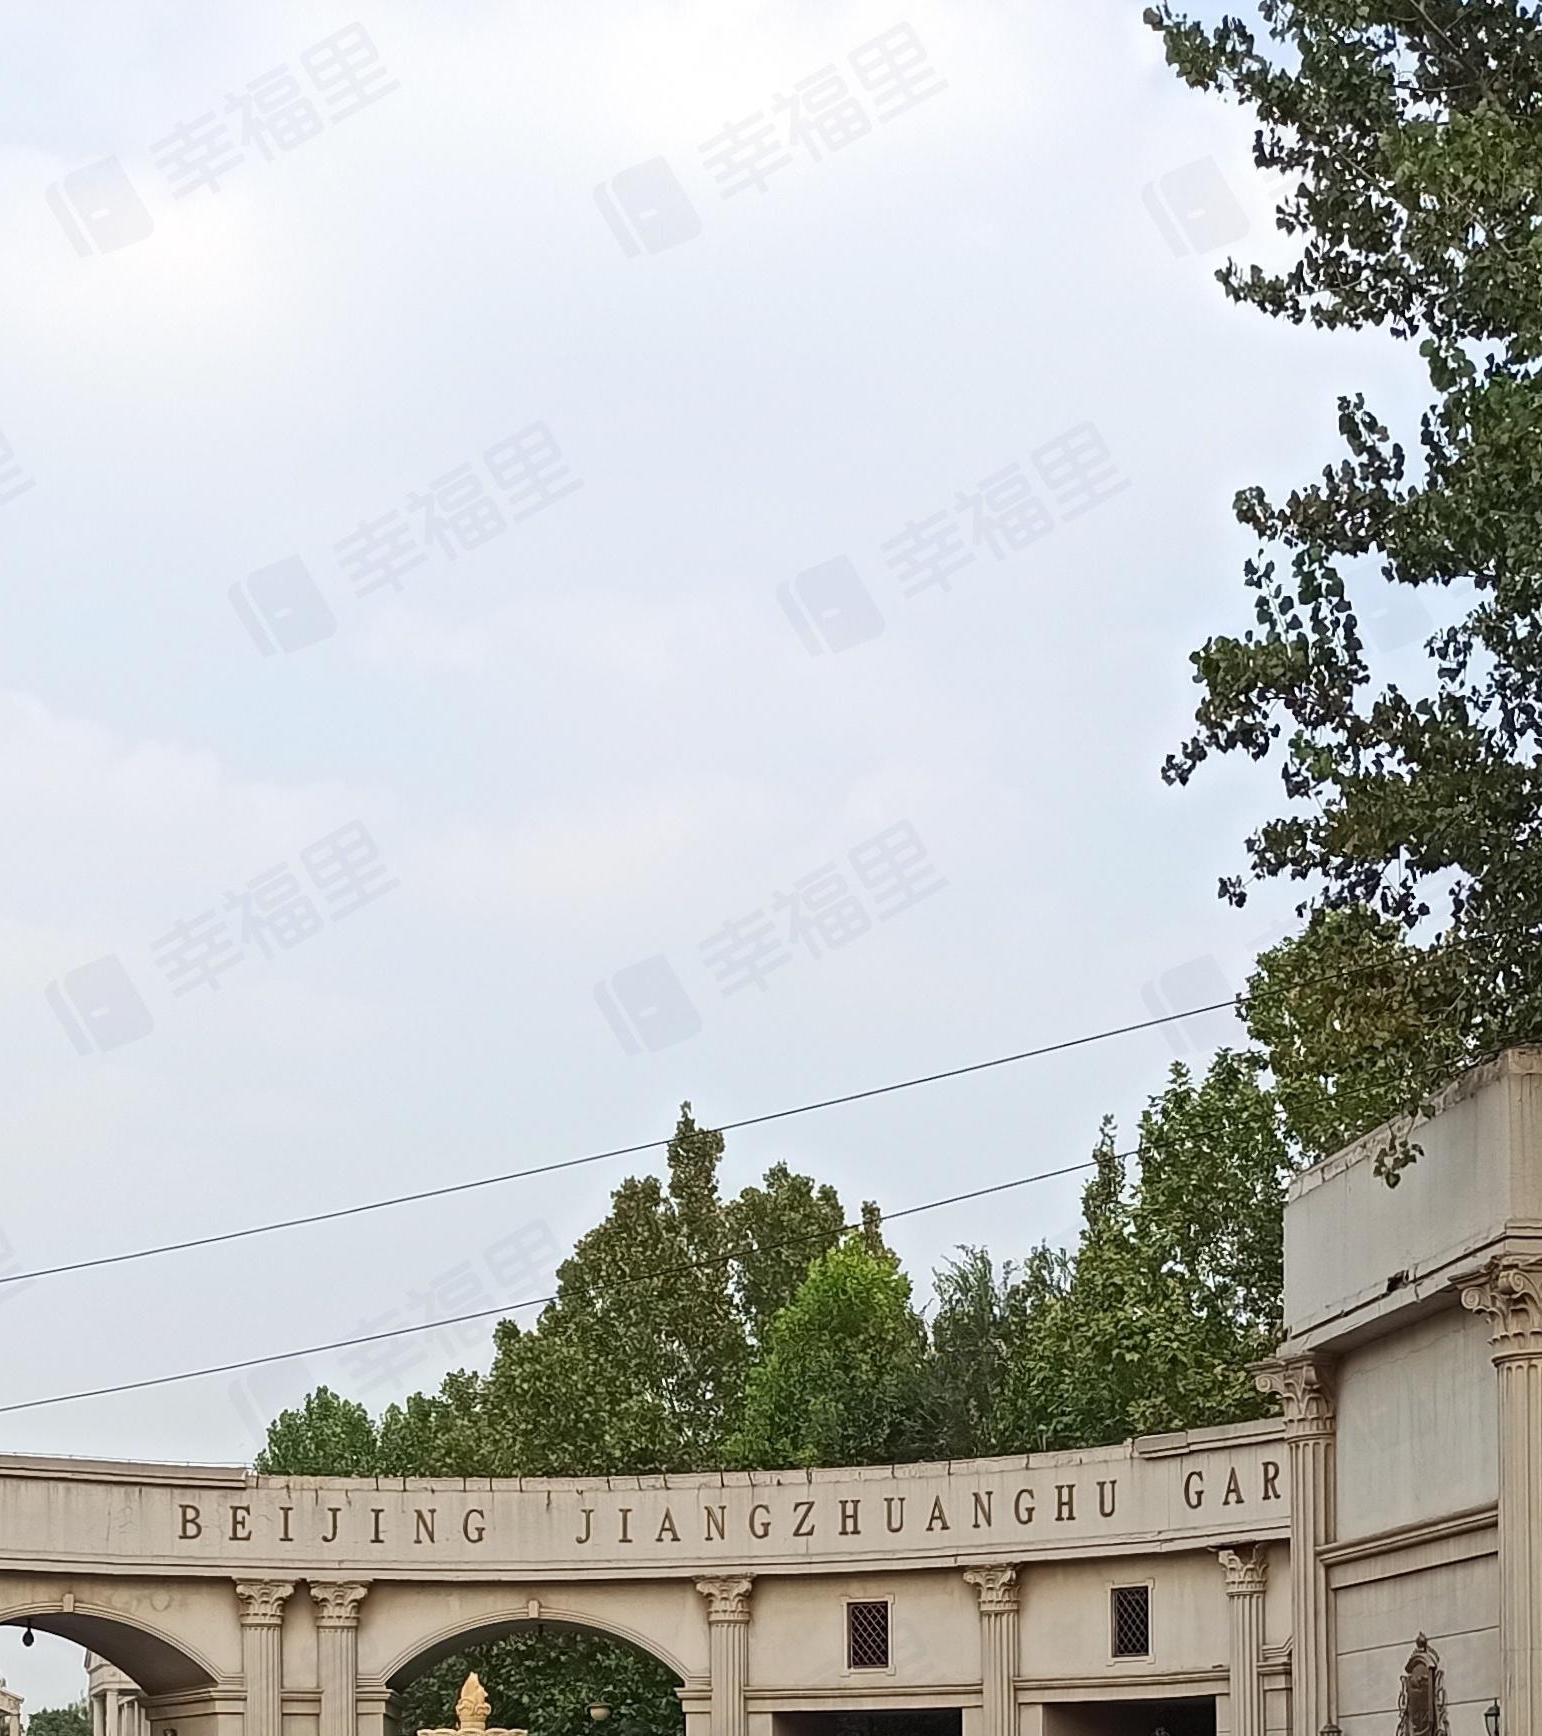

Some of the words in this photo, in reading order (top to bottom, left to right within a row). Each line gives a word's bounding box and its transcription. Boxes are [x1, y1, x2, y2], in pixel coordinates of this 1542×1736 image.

[178, 1504, 487, 1545] BEIJING
[576, 1479, 1117, 1545] JIANGZHUANGHU
[1183, 1460, 1281, 1510] GAR
